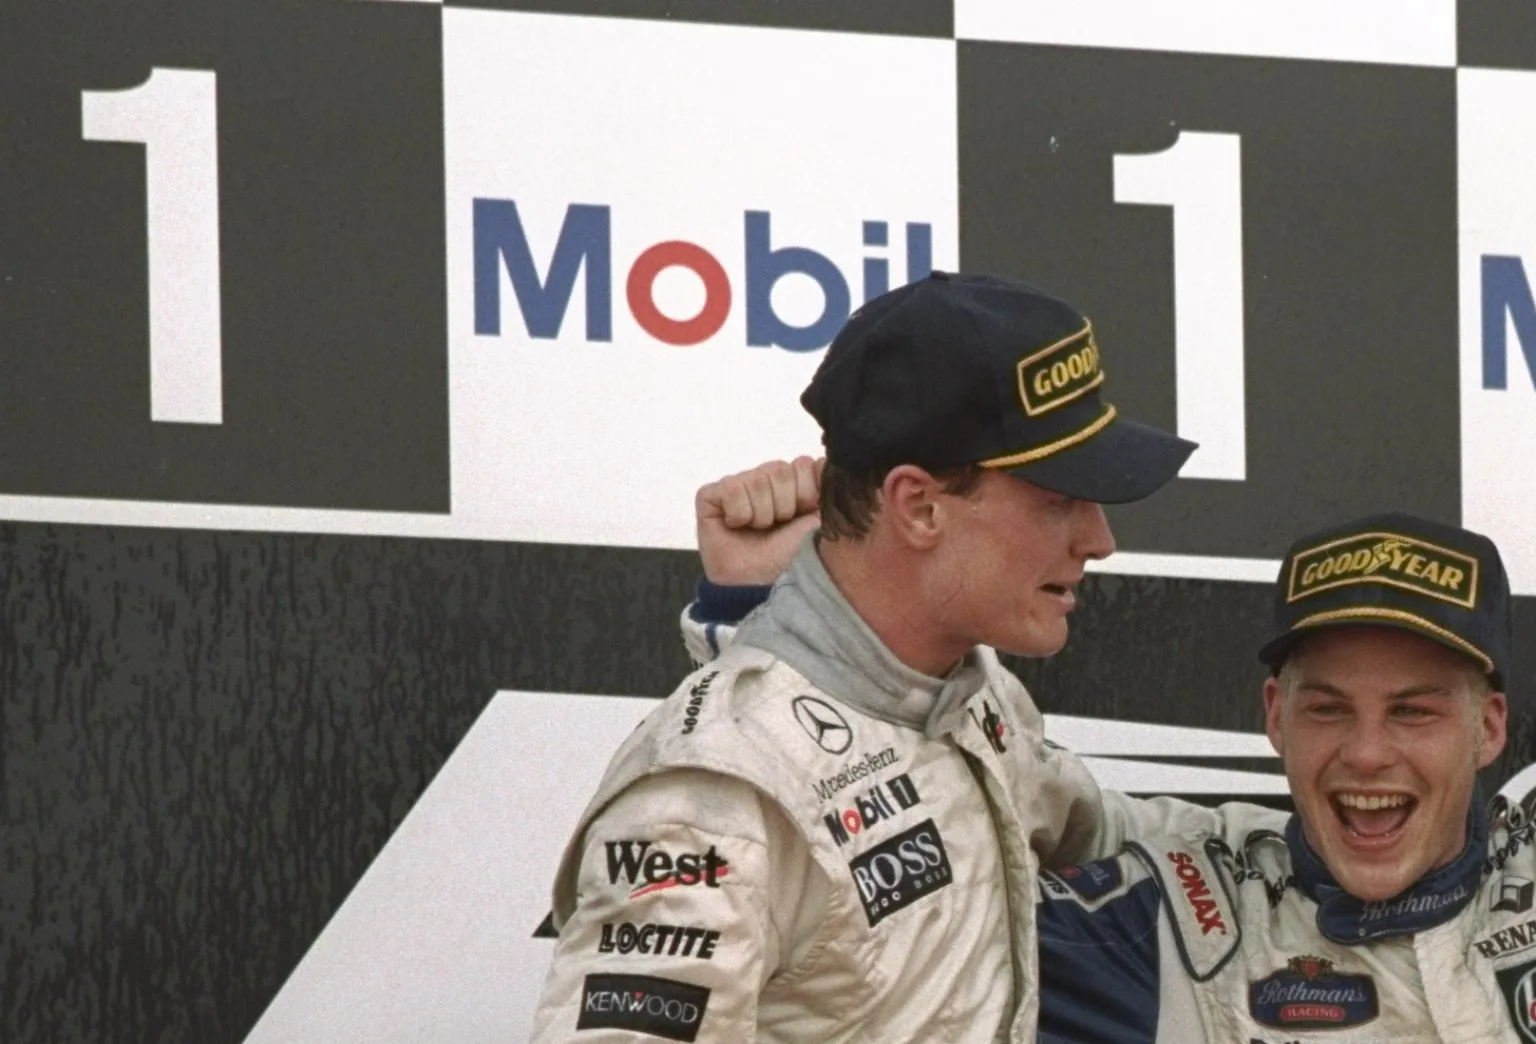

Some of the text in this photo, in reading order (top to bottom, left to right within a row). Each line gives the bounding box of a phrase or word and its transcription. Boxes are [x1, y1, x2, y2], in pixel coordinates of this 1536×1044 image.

[82, 67, 223, 424] 1
[1112, 130, 1246, 481] 1
[1302, 545, 1465, 590] GOODYEAR
[823, 785, 896, 848] Mobil
[604, 841, 729, 888] West
[853, 832, 941, 903] BOSS
[1167, 852, 1227, 935] SONAX
[598, 922, 722, 960] LOCTITE
[585, 991, 698, 1024] KENWOOD
